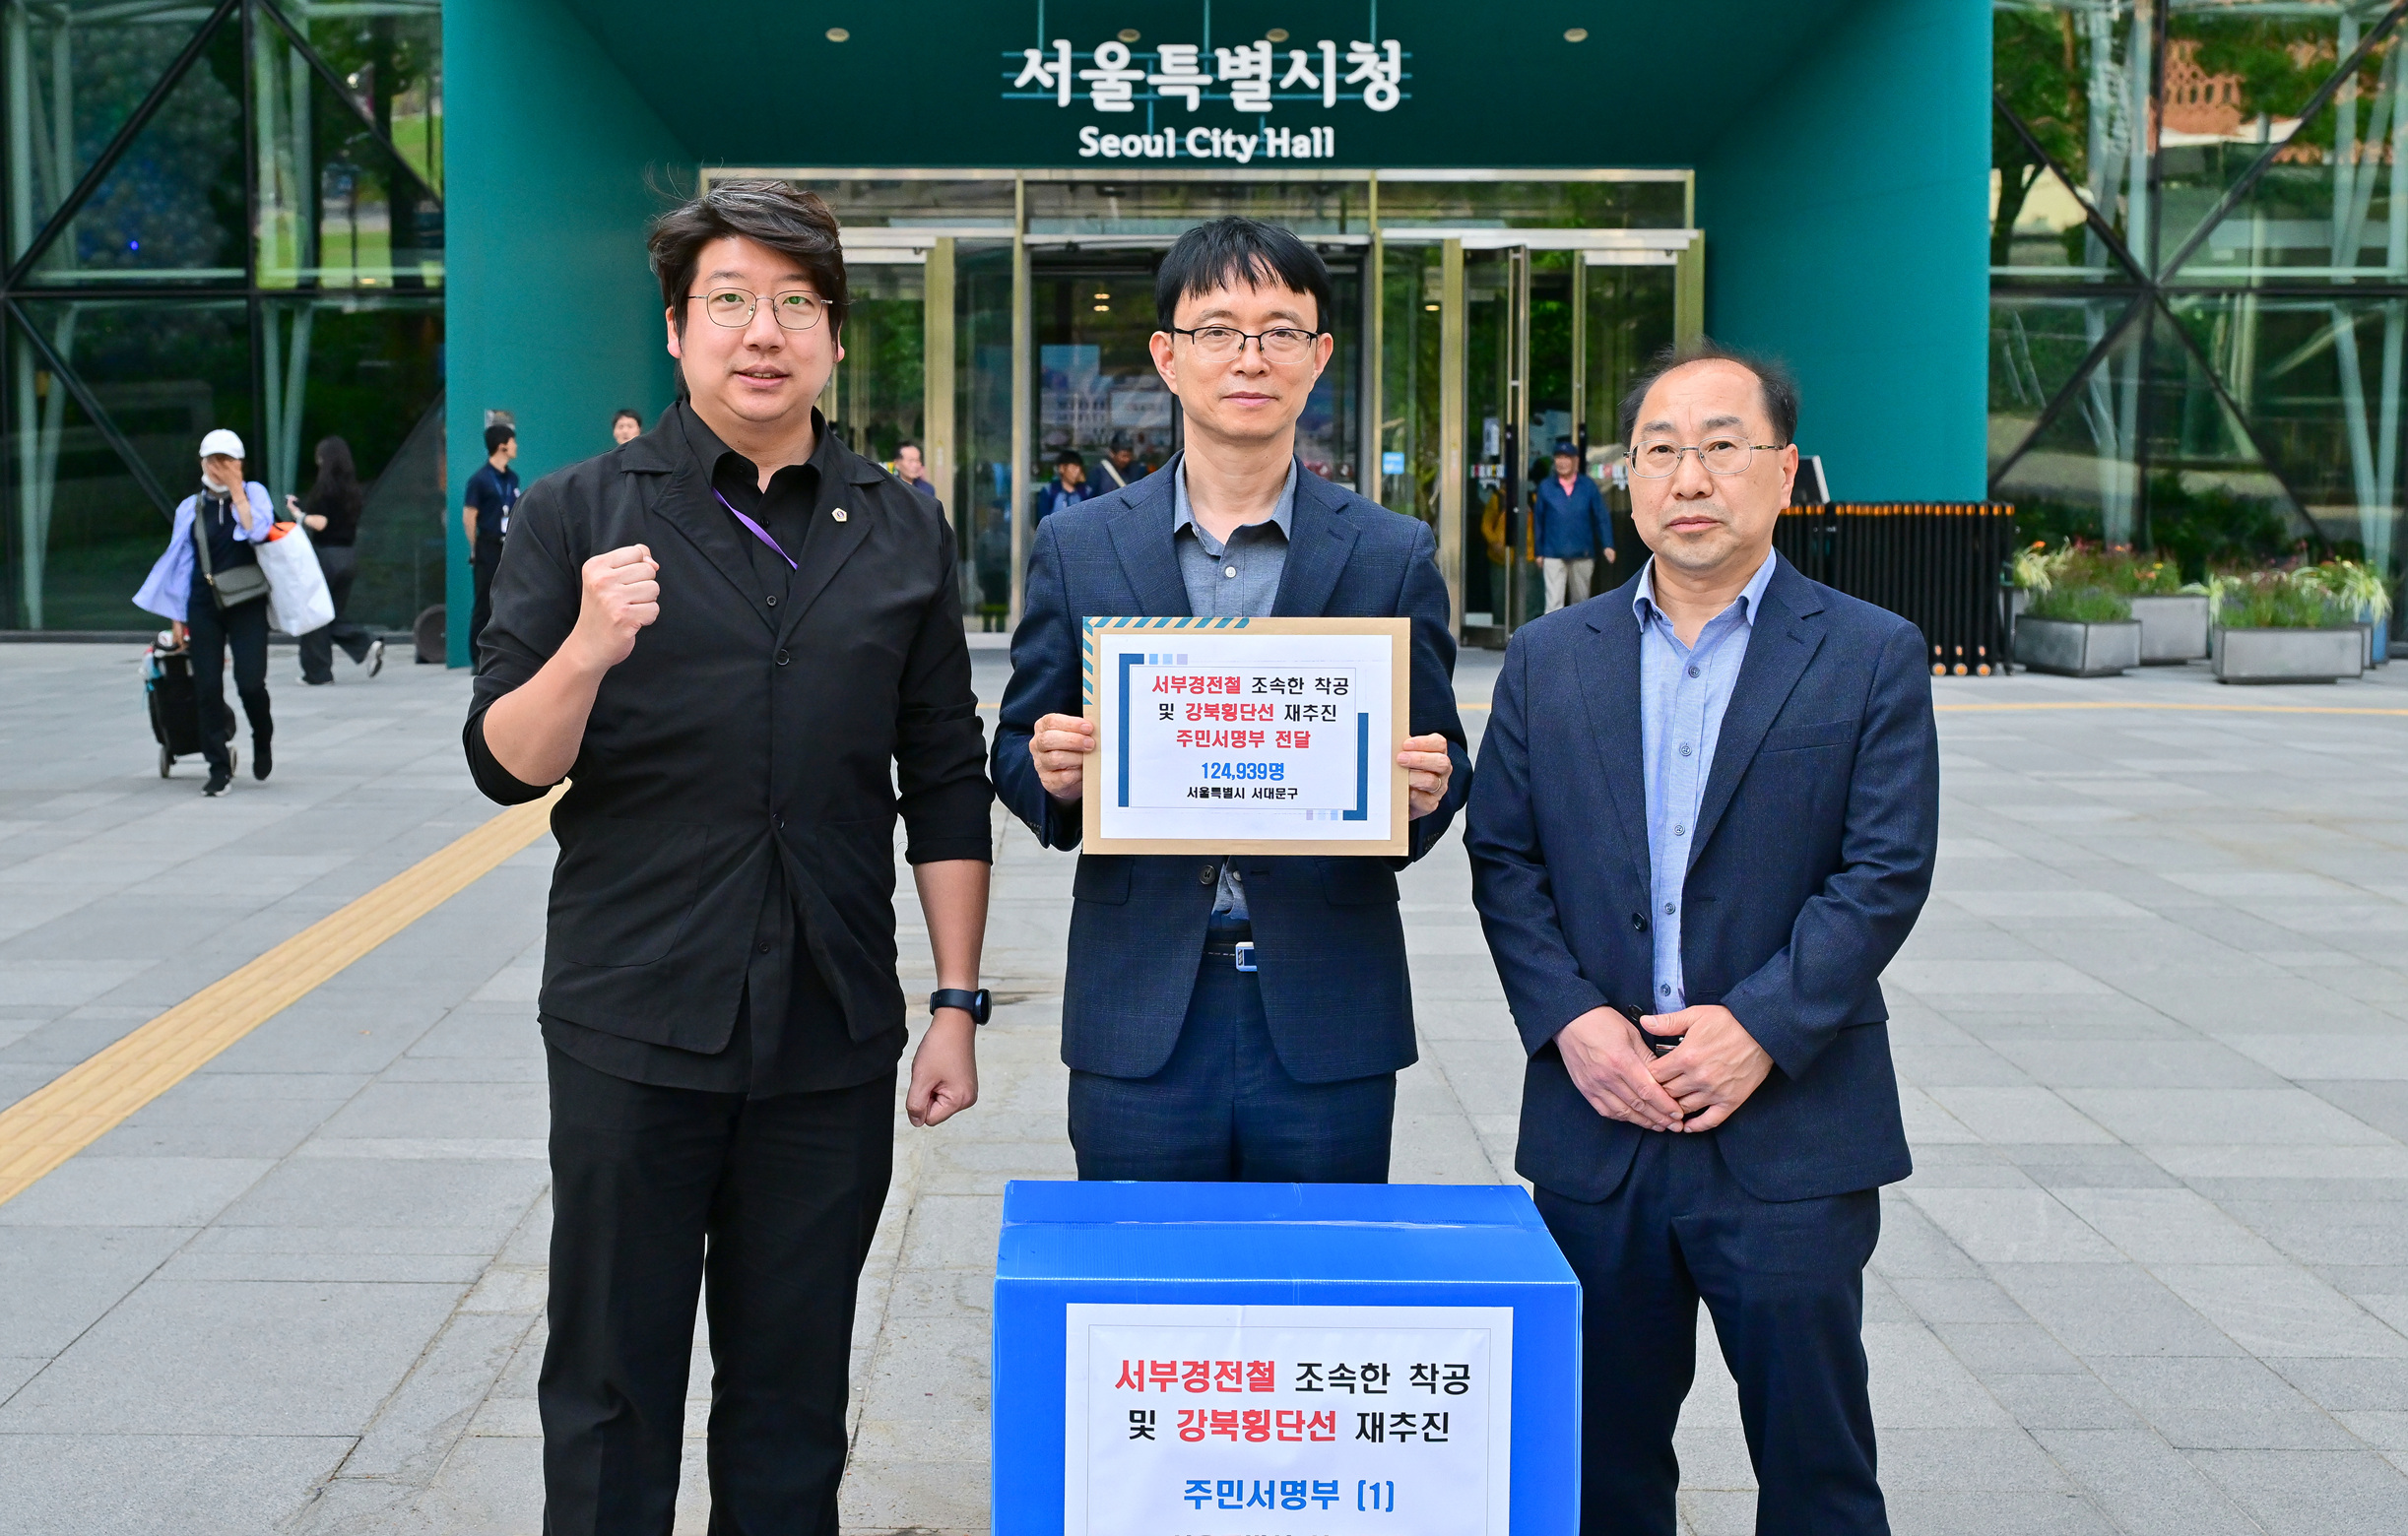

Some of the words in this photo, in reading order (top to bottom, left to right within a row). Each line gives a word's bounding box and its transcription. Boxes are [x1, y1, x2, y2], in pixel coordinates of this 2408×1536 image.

[1014, 39, 1401, 112] 서울특별시청
[1078, 126, 1176, 159] Seoul
[1186, 126, 1259, 163] City
[1264, 126, 1334, 159] Hall
[1151, 675, 1241, 695] 서부경전철
[1251, 676, 1305, 695] 조속한
[1314, 676, 1349, 696] 착공
[1158, 702, 1175, 721] 및
[1185, 702, 1274, 722] 강북횡단선
[1283, 703, 1336, 723] 재추진
[1176, 730, 1266, 749] 주민서명부
[1274, 730, 1311, 749] 전달
[1201, 761, 1285, 782] 124,939명
[1186, 786, 1245, 800] 서울특별시
[1251, 787, 1298, 800] 서대문구
[1114, 1359, 1275, 1394] 서부경전철
[1294, 1362, 1392, 1395] 조속한
[1408, 1363, 1470, 1396] 착공
[1129, 1409, 1156, 1441] 및
[1176, 1409, 1336, 1443] 강북횡단선
[1354, 1411, 1449, 1443] 재추진
[1183, 1479, 1340, 1511] 주민서명부
